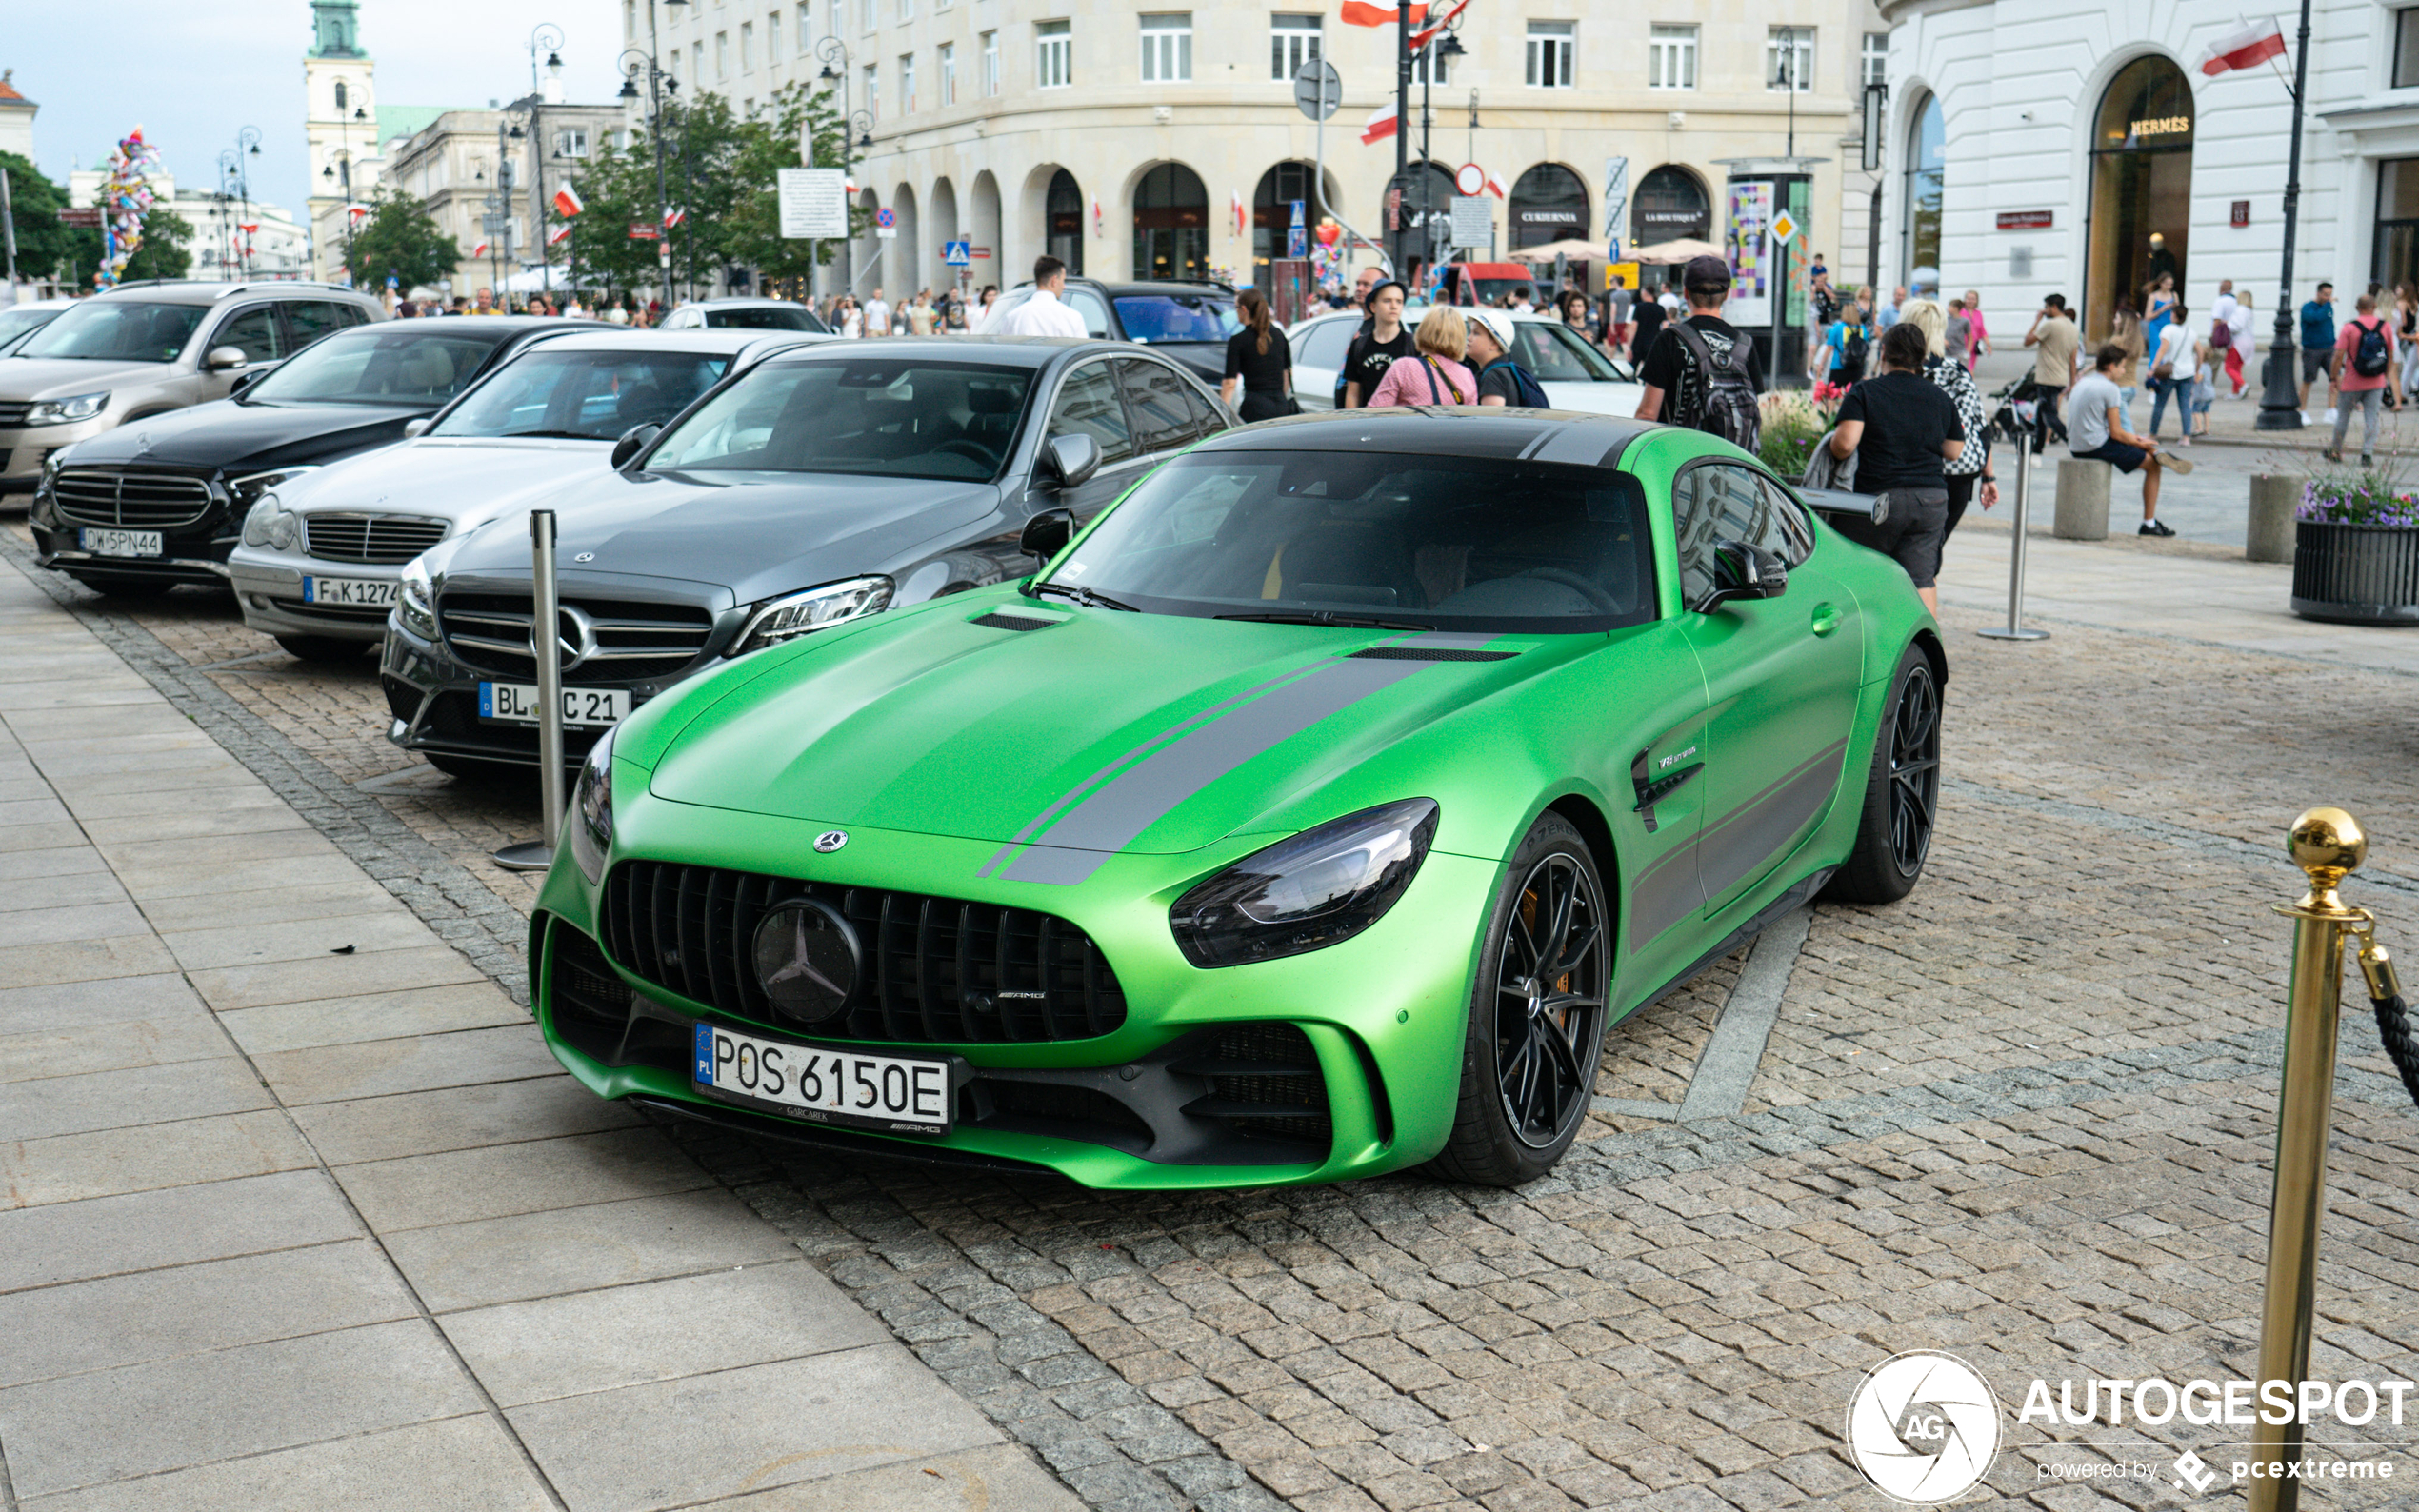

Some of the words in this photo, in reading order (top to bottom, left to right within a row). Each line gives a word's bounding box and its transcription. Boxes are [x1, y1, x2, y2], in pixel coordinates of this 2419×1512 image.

[1521, 211, 1577, 222] CUKIERNIA
[88, 530, 104, 548] DW
[110, 532, 158, 551] 5PN44
[320, 580, 330, 599] F
[341, 582, 352, 602] K
[498, 687, 528, 715] BL
[563, 692, 579, 719] C
[586, 693, 617, 721] 21
[1538, 823, 1574, 842] ZERO
[699, 1060, 711, 1075] PL
[716, 1034, 784, 1095] POS
[800, 1055, 941, 1117] 6150E
[787, 1106, 828, 1120] GARCAREK
[905, 1124, 941, 1133] AMG
